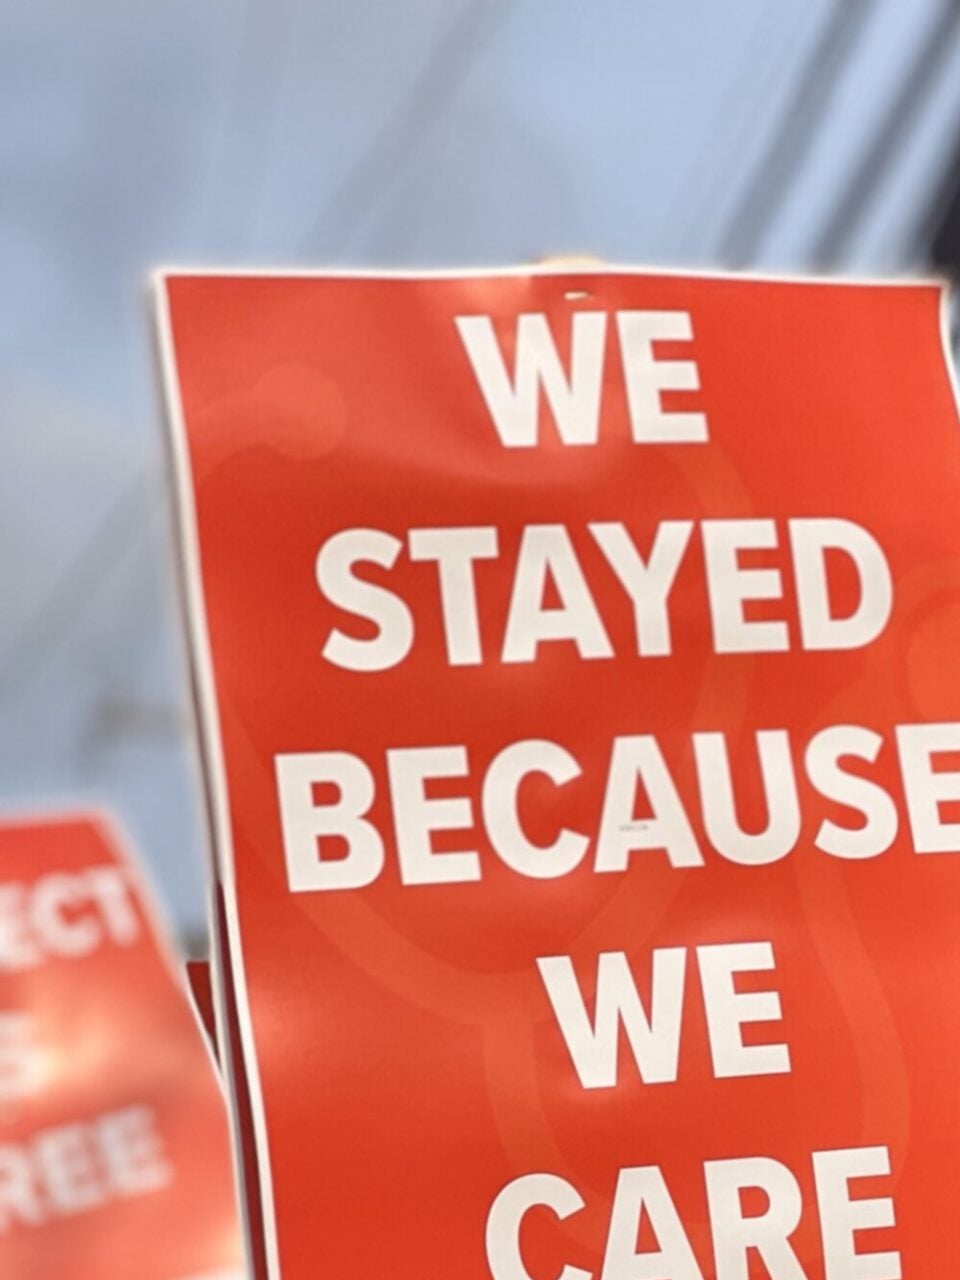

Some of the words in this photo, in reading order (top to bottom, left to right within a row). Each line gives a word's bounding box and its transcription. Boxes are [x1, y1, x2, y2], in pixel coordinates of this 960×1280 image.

[455, 310, 708, 448] WE
[316, 518, 892, 671] STAYED
[536, 942, 790, 1089] WE
